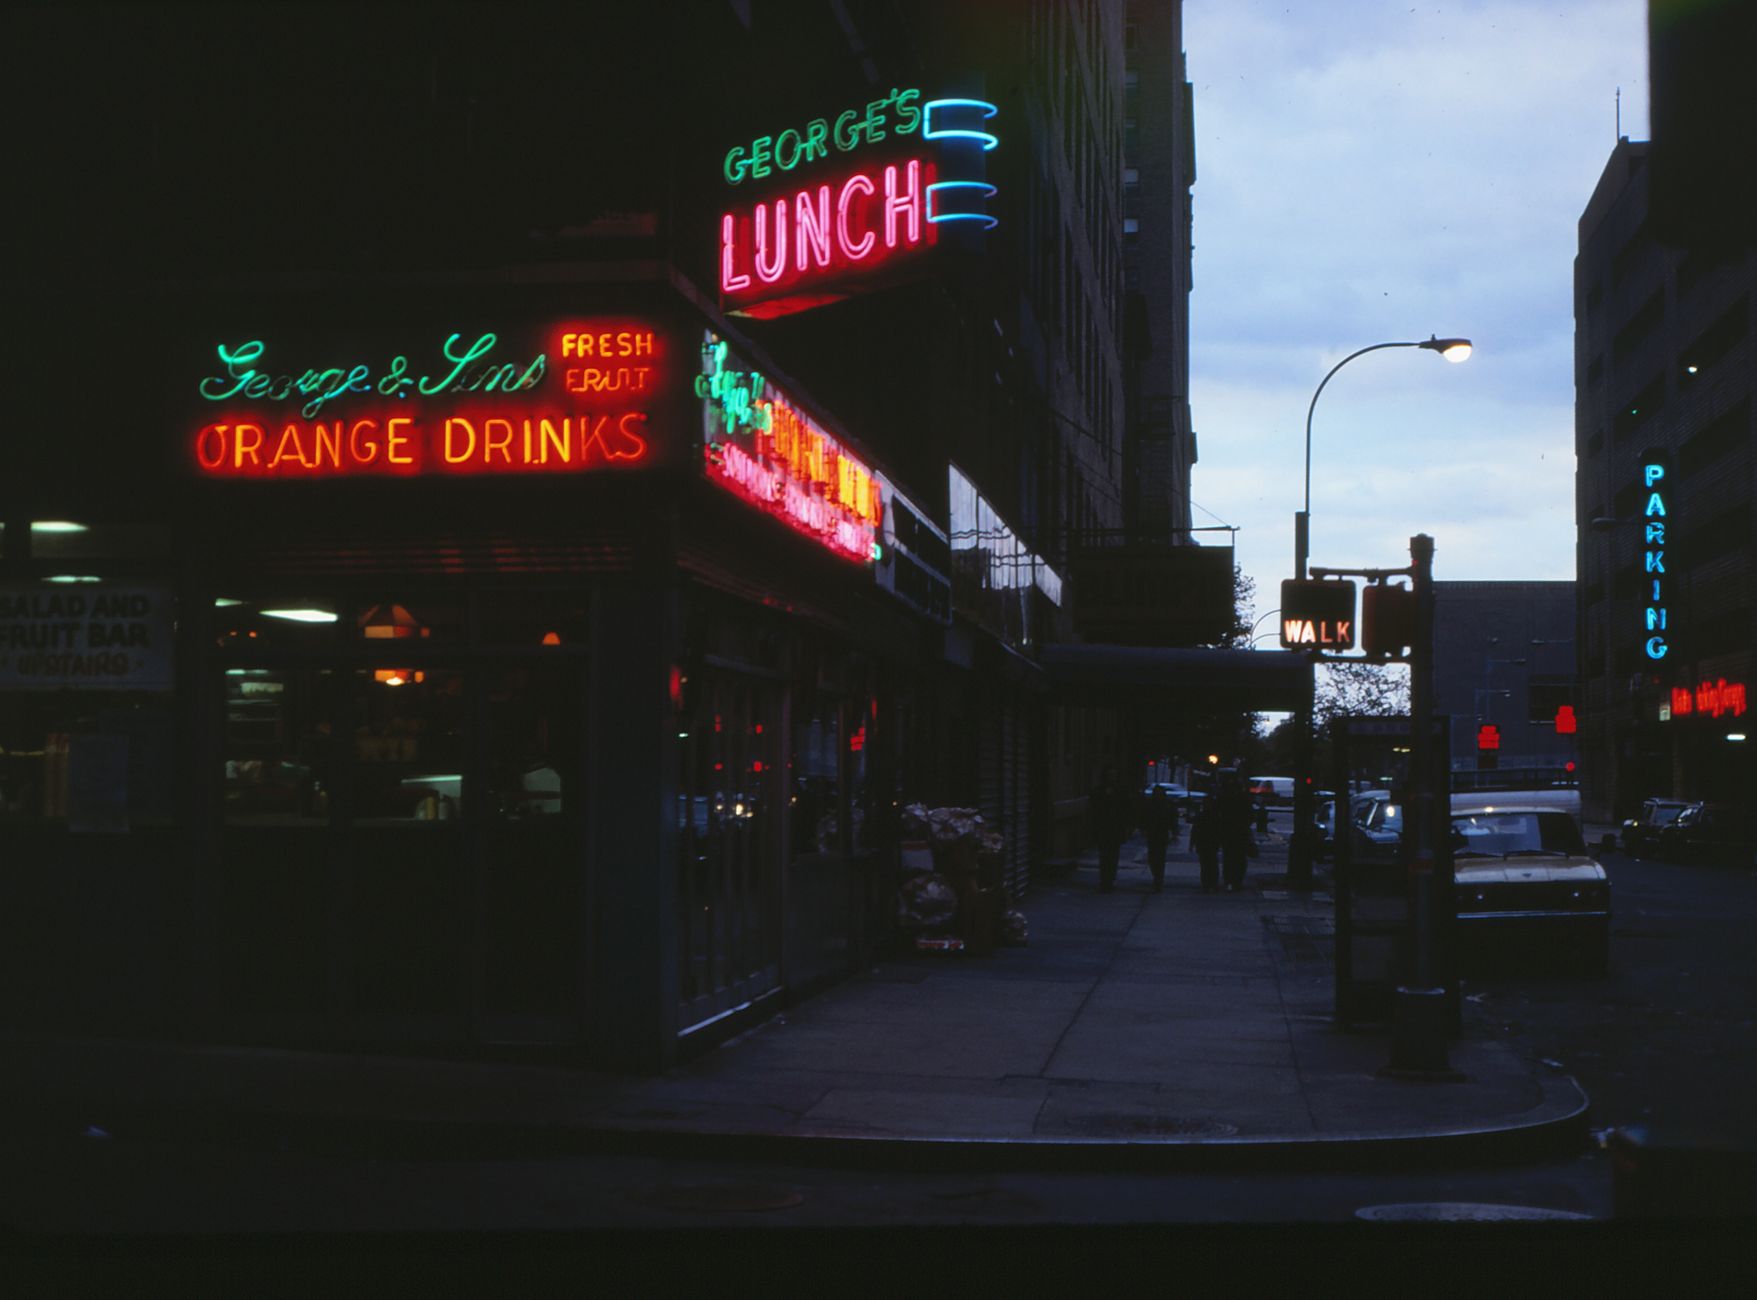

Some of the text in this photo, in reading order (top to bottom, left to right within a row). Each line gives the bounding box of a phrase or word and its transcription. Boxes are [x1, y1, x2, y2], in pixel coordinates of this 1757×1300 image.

[724, 88, 921, 184] GEORGE'S
[723, 160, 919, 291] LUNCH
[562, 333, 653, 358] FRESH
[200, 340, 371, 418] George
[378, 356, 414, 398] &
[566, 367, 649, 392] FRUIT
[199, 413, 648, 468] ORANGE DRINKS
[1644, 464, 1668, 660] PARKING
[0, 594, 151, 619] SALAD AND
[88, 622, 150, 648] BAR
[1284, 620, 1350, 643] WALK
